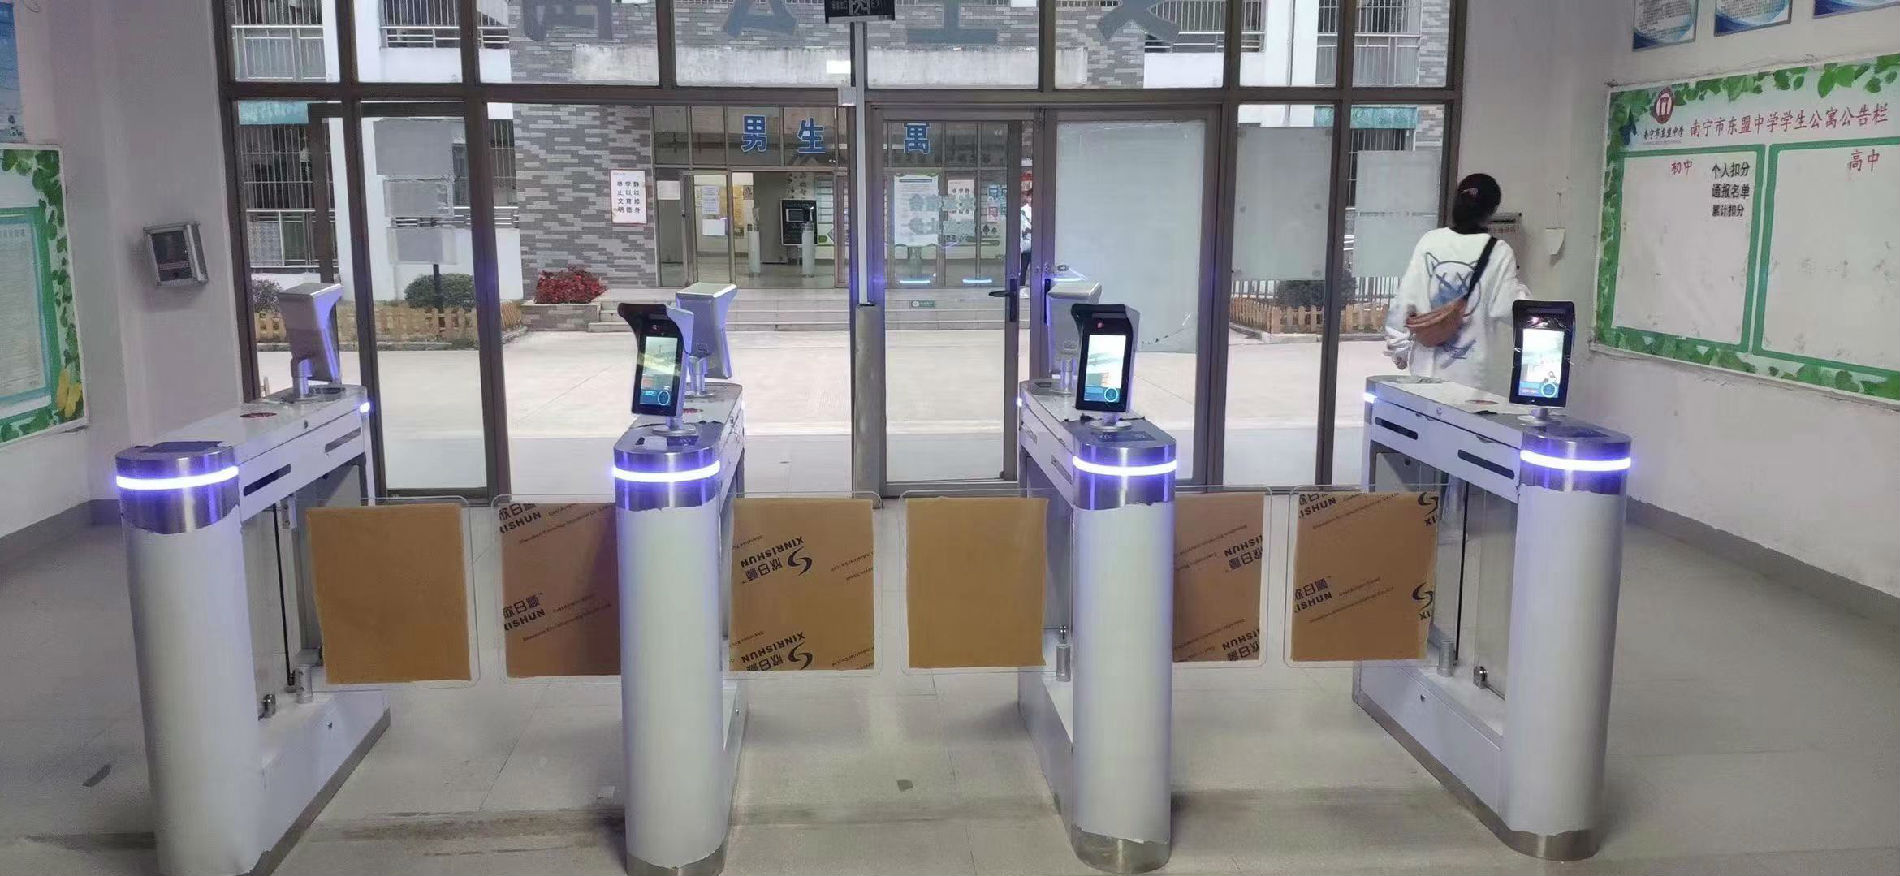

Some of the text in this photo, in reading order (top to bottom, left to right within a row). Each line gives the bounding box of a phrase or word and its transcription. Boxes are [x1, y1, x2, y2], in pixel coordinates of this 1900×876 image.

[1690, 102, 1888, 138] 南宁市东盟中学学生公寓公告栏
[1671, 159, 1693, 176] 初中
[1711, 161, 1750, 179] 个人扣分
[1848, 148, 1880, 172] 高中
[1711, 183, 1750, 199] 通报名单
[741, 536, 804, 568] XINRISHUN
[741, 631, 805, 663] XINRISHUN
